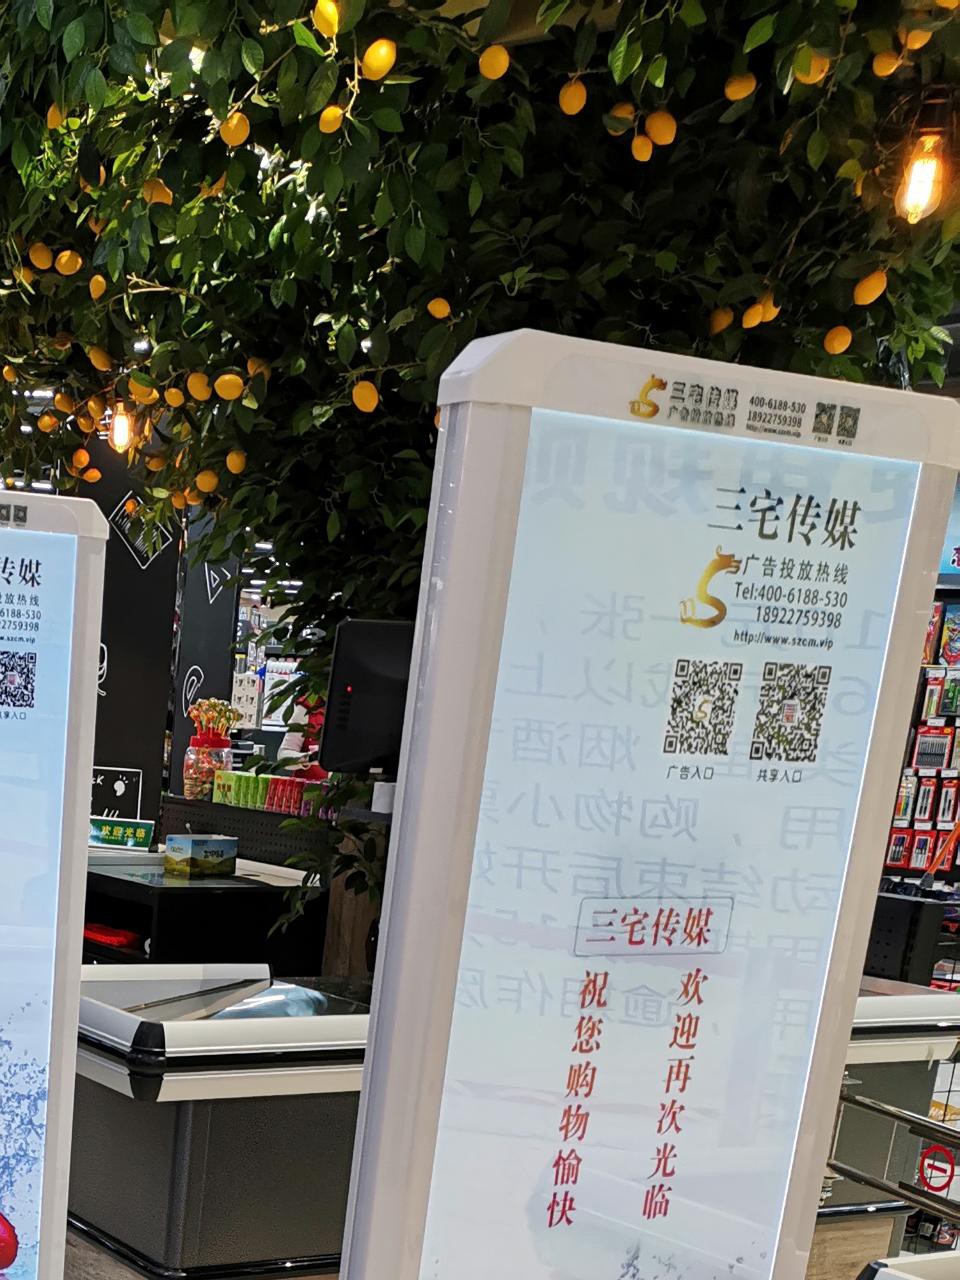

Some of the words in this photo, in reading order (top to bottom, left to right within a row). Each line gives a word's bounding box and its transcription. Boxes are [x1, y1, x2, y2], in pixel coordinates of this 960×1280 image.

[749, 395, 807, 414] 400-6188-530
[746, 410, 802, 429] 18922759398
[707, 486, 862, 551] 三宅传媒
[742, 554, 849, 585] 广告投放热线
[734, 581, 848, 609] Tel:400-6188-530
[755, 605, 842, 629] 18922759398
[733, 629, 834, 651] http://www.szcm.vip
[666, 764, 714, 781] 广告入口
[756, 768, 803, 784] 共享入口
[585, 906, 715, 948] 三宅传媒
[546, 970, 610, 1228] 祝您购物愉快
[642, 967, 708, 1221] 欢迎再次光临
